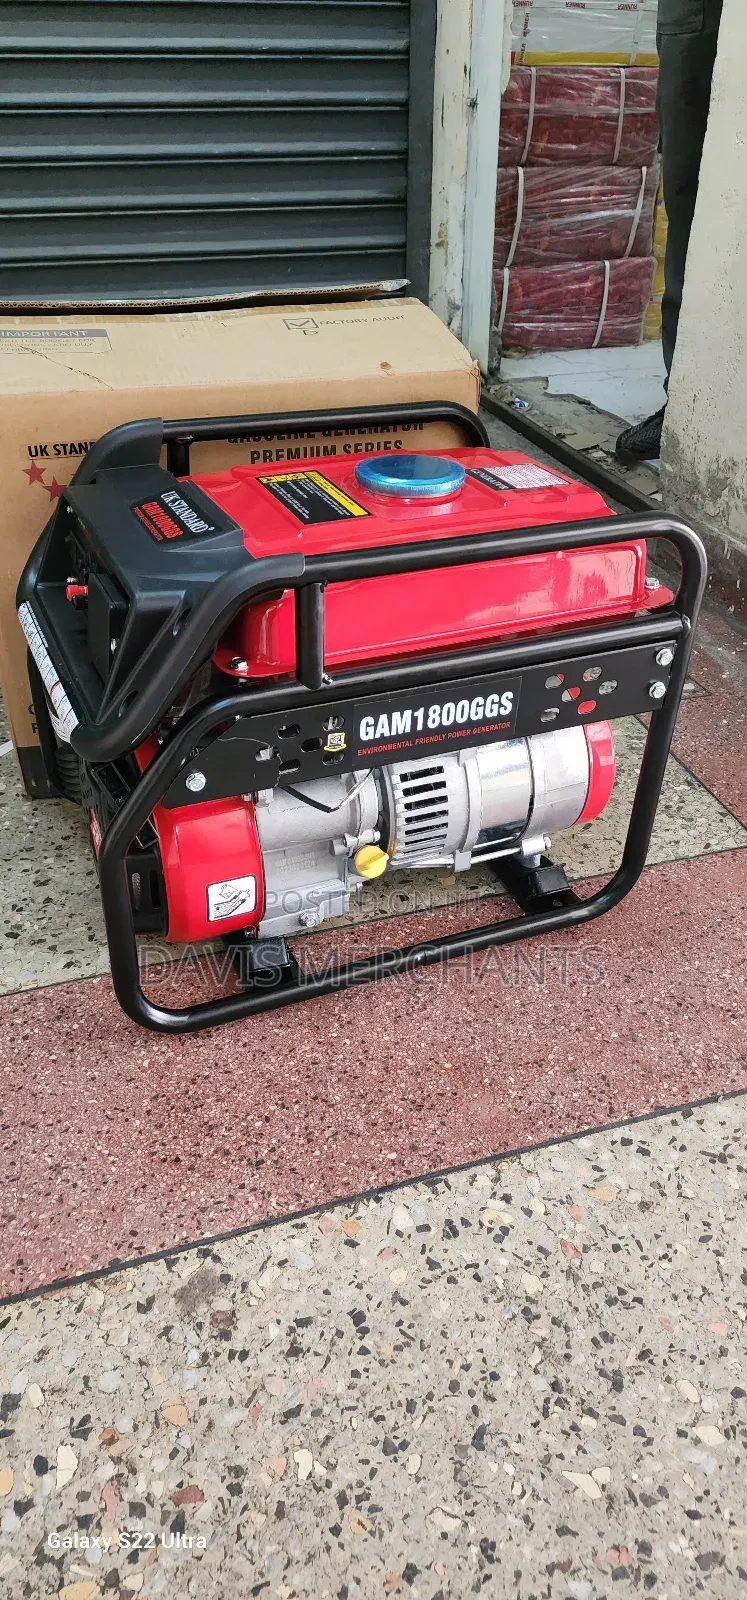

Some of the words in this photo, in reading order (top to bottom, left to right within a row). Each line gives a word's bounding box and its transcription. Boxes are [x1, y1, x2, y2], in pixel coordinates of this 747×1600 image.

[565, 1, 586, 9] RUNNER
[319, 318, 368, 326] FACTORY
[1, 330, 88, 338] IMPORTANT
[27, 445, 50, 457] UK
[250, 445, 337, 465] PREMIUM
[342, 439, 403, 455] SERIES
[160, 490, 180, 507] UK
[359, 691, 514, 741] GAM1800GGS
[357, 740, 414, 757] ENVIRONMENTAL
[415, 733, 447, 745] FRIENDLY
[447, 729, 471, 740] POWER
[472, 721, 511, 735] GENERATOR
